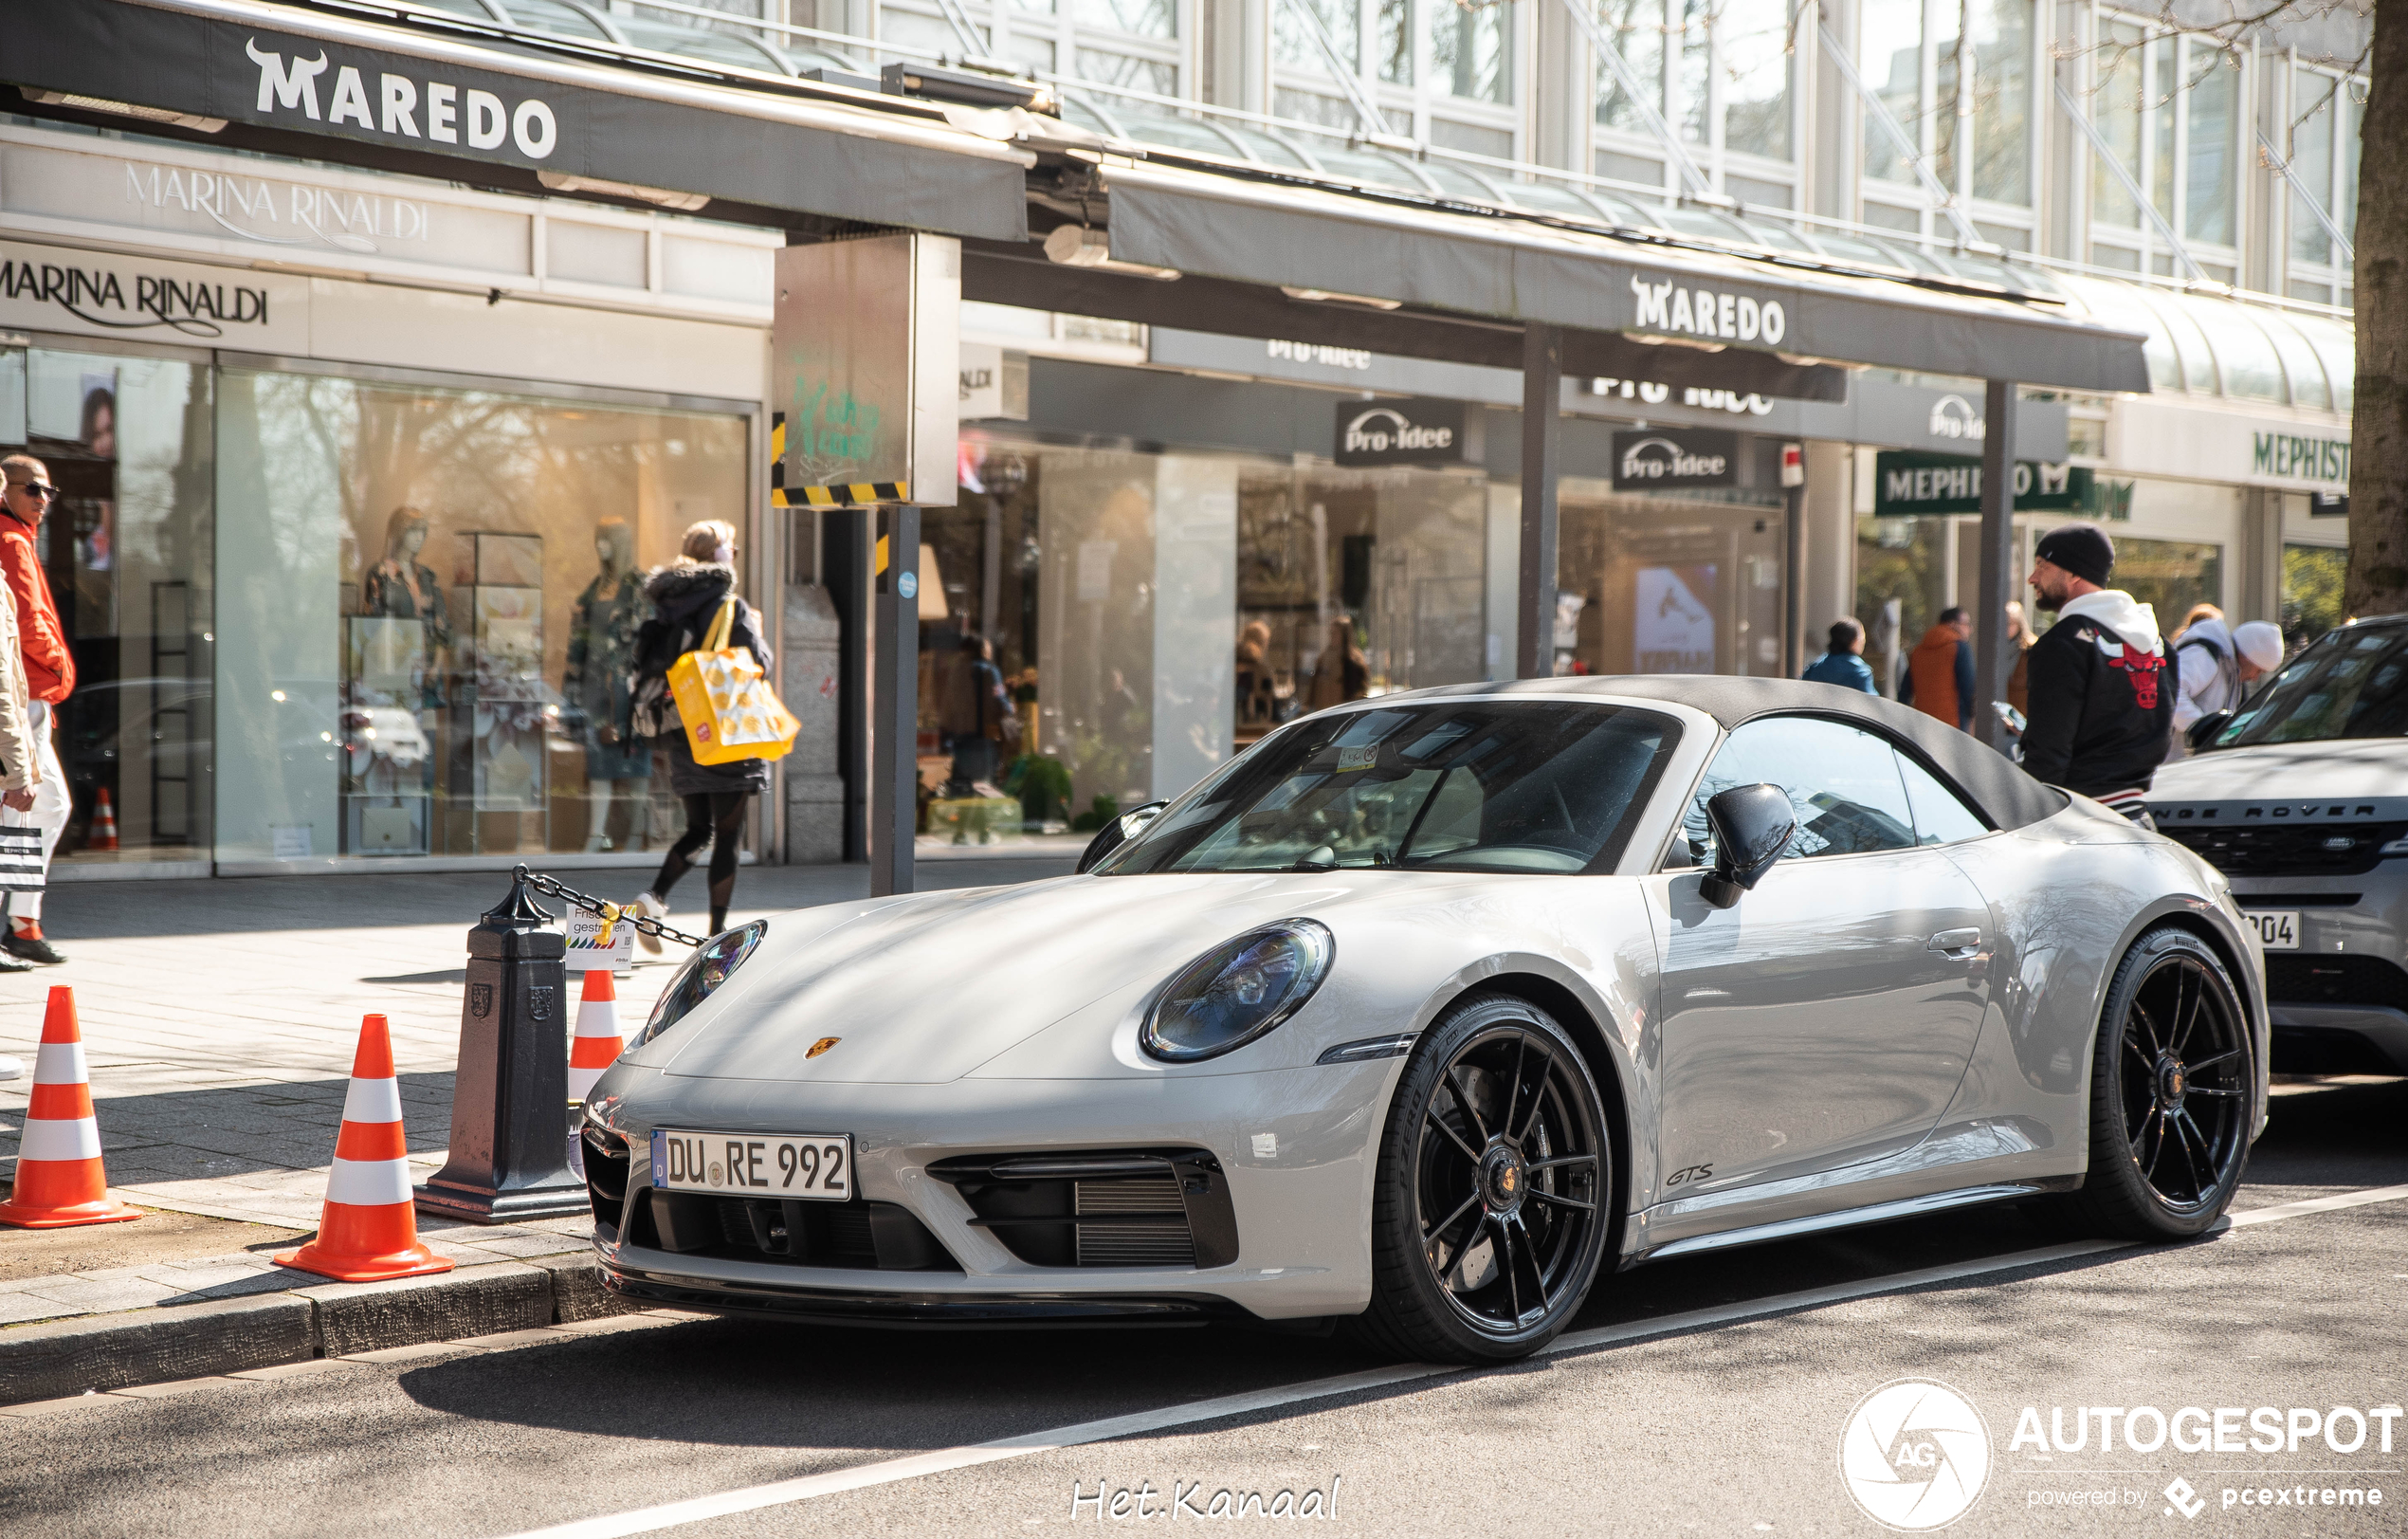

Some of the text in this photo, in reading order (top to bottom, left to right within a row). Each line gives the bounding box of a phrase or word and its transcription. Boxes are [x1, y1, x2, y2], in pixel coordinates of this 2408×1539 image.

[246, 36, 557, 159] MAREDO
[123, 161, 429, 252] MARINA RINALDI
[136, 275, 268, 338] RINALDI
[1631, 274, 1786, 345] MAREDO
[1885, 462, 2033, 503] MEPHIO
[2245, 806, 2377, 818] ROVER
[656, 1165, 664, 1178] D
[667, 1139, 845, 1190] DU RE 992
[1666, 1163, 1714, 1187] GTS
